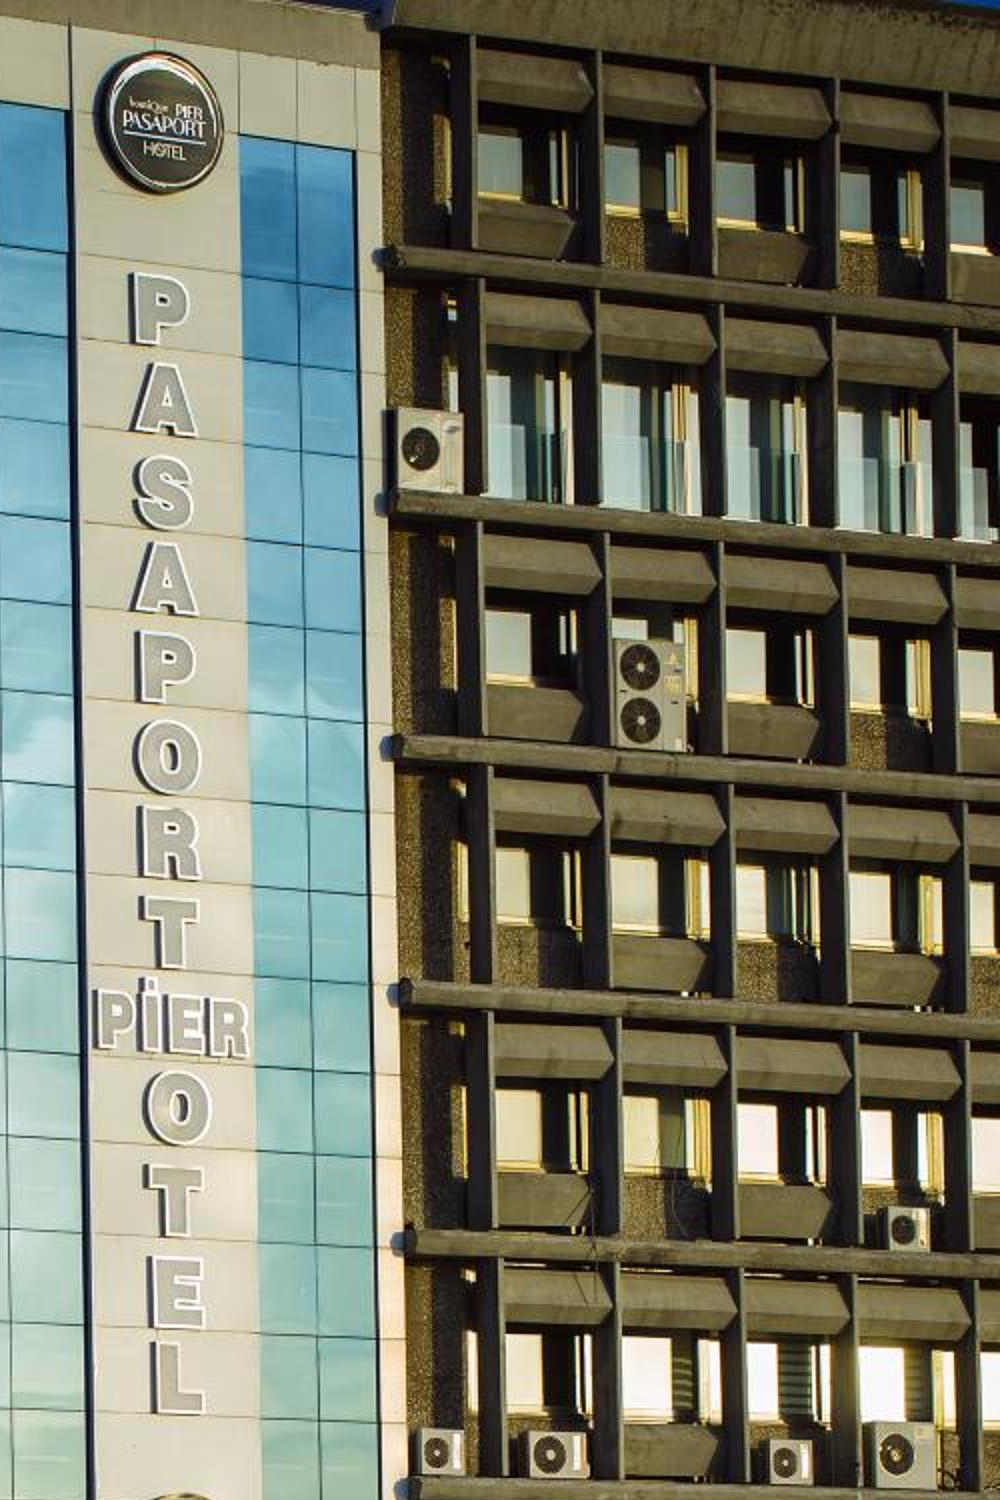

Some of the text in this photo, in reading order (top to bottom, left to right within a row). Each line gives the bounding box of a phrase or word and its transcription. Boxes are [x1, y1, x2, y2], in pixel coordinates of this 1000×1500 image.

[123, 109, 207, 139] PASAPORT
[175, 103, 203, 120] PIER
[143, 140, 187, 161] HOTEL
[130, 272, 201, 970] PASAPORT
[145, 1070, 212, 1415] OTEL
